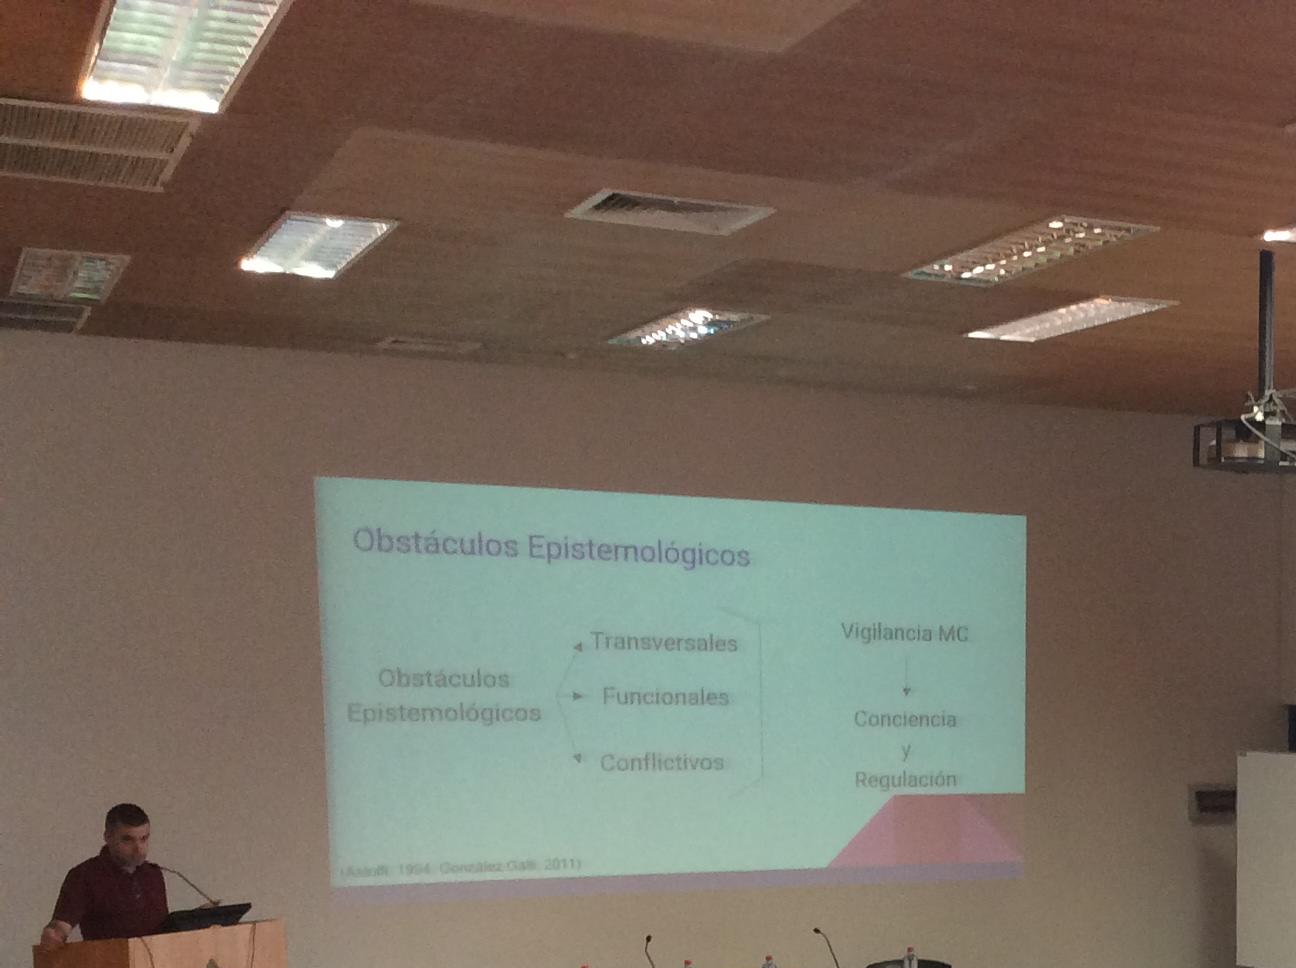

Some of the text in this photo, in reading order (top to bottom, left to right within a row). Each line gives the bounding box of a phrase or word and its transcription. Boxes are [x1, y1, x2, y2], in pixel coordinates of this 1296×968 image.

[353, 527, 751, 571] Obstáculos Epistemológicos
[590, 631, 738, 653] Transversales
[841, 622, 969, 644] Vigilancia MC
[379, 669, 510, 689] Obstáculos
[603, 687, 730, 706] Funcionales
[347, 703, 542, 727] Epistemológicos
[854, 710, 957, 728] Conciencia
[902, 744, 911, 761] y
[601, 754, 725, 773] Conflictivos
[855, 770, 958, 792] Regulación
